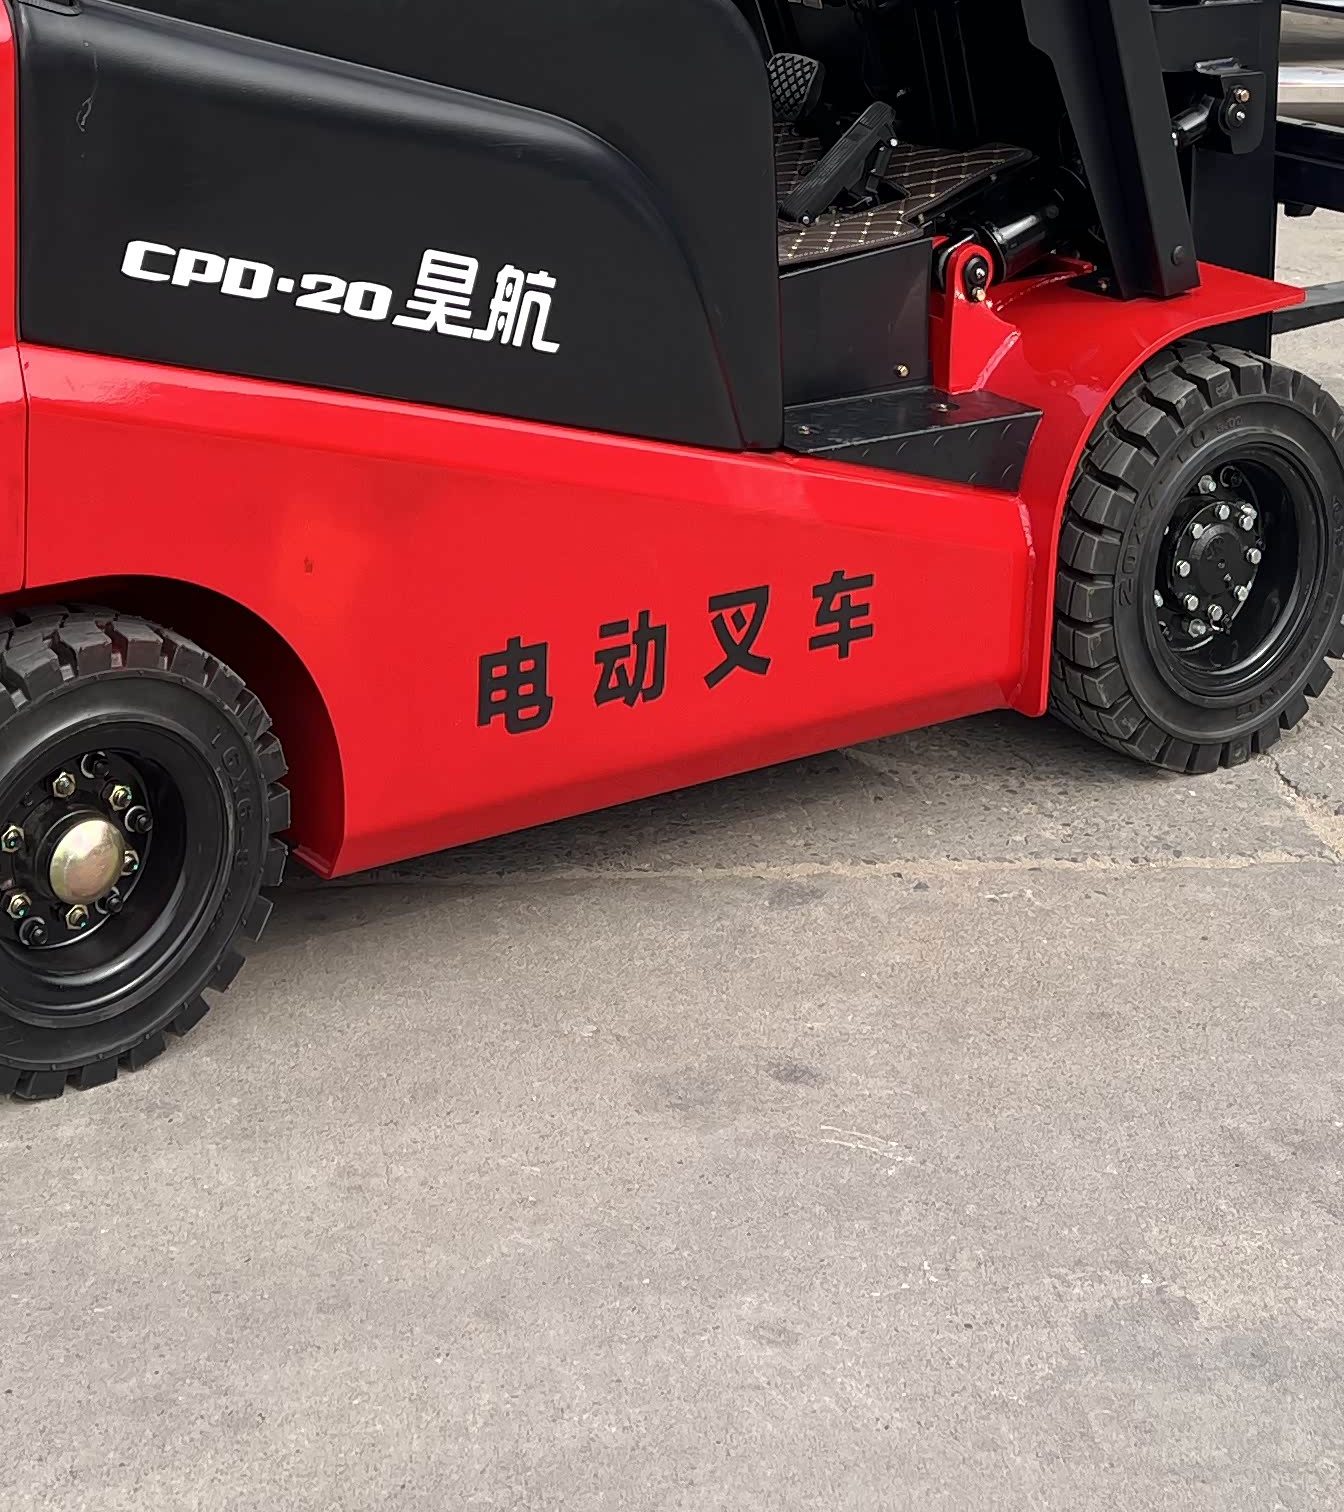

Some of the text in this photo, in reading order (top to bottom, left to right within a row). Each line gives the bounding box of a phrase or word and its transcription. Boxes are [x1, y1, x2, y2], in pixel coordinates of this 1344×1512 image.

[392, 248, 561, 354] 昊航
[476, 570, 875, 735] 电动叉车
